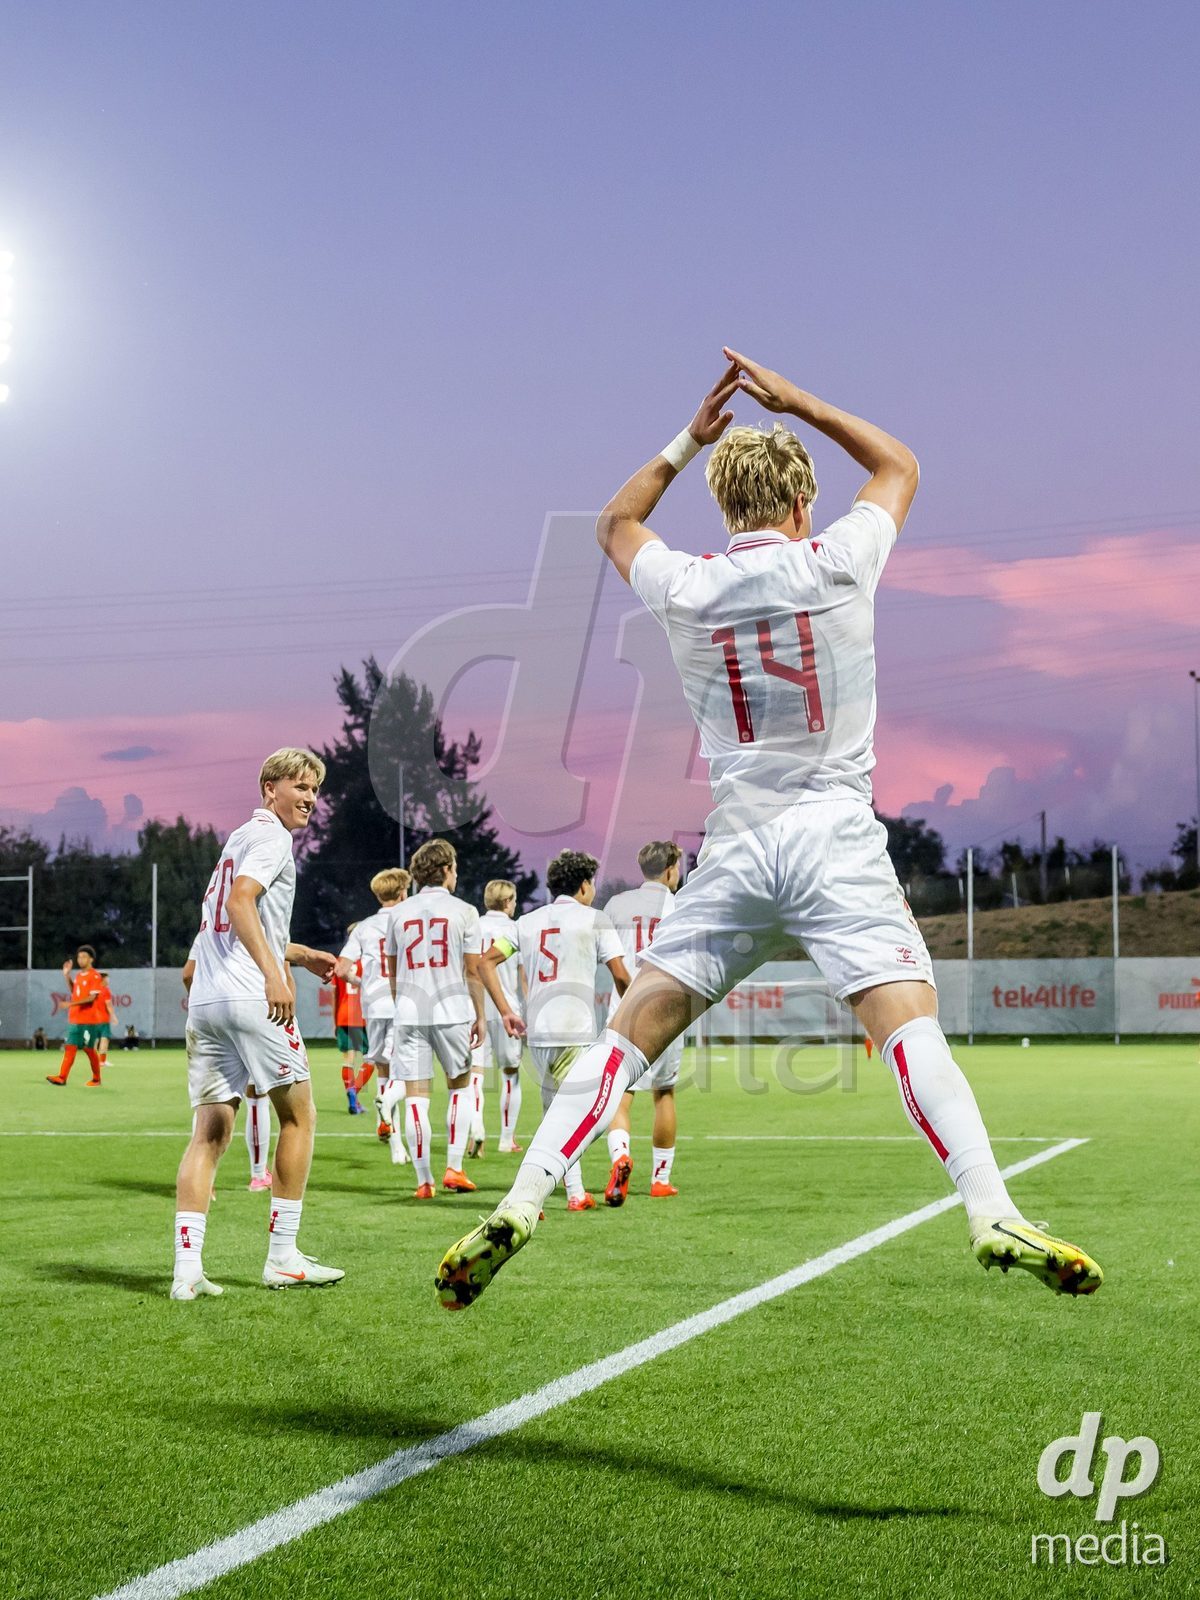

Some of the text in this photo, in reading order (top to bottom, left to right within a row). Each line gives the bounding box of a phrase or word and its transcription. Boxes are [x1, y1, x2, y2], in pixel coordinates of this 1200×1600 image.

[711, 610, 826, 743] 14
[403, 917, 449, 971] 23
[538, 927, 561, 983] 5
[632, 915, 662, 953] 1
[991, 983, 1096, 1009] tek4life
